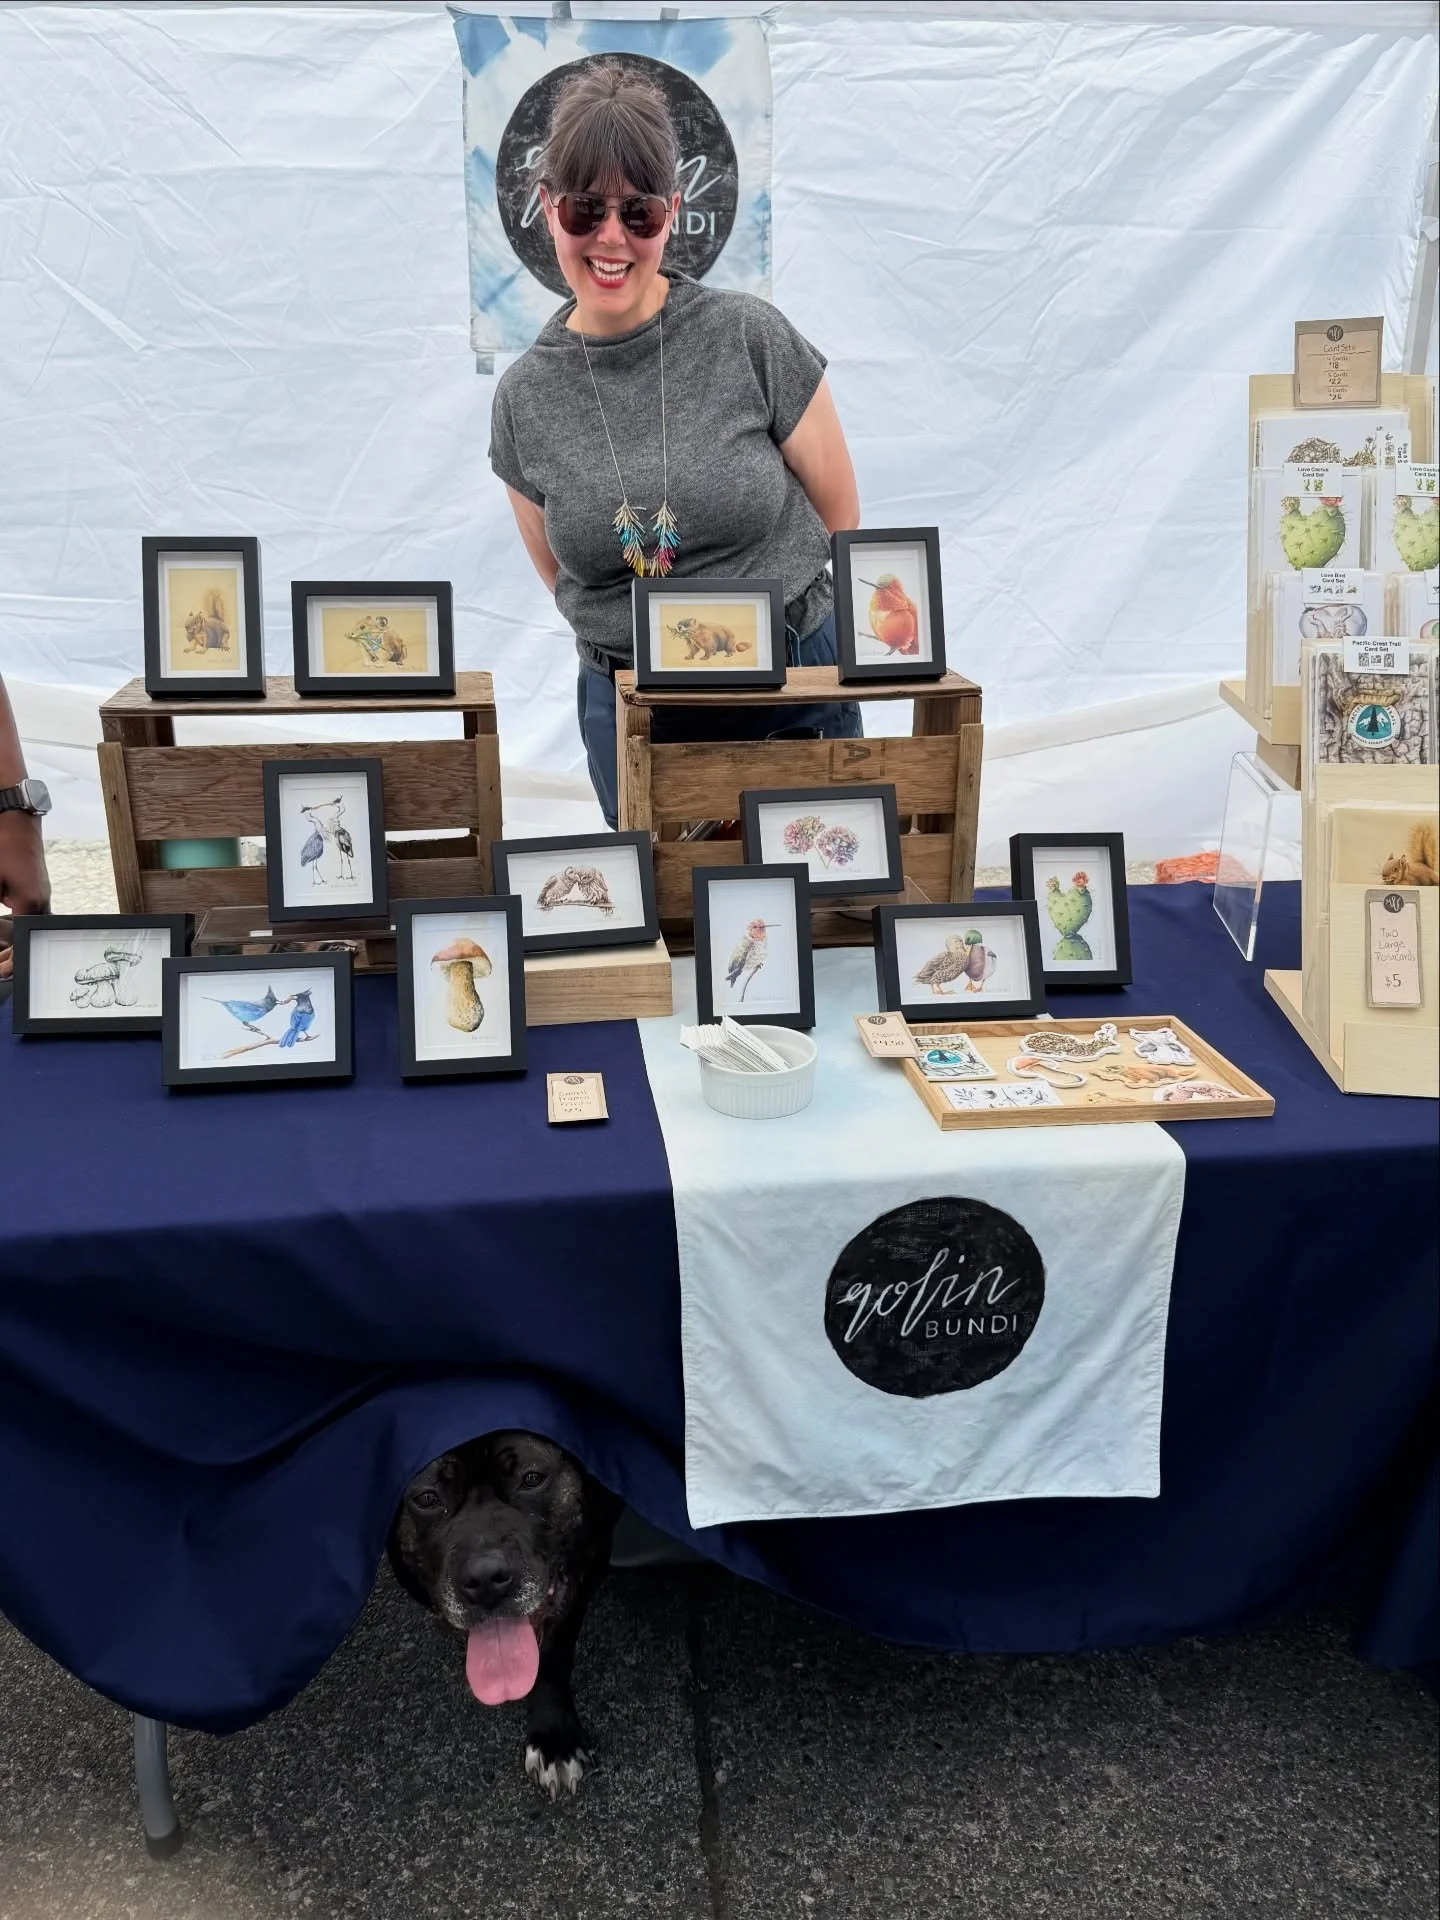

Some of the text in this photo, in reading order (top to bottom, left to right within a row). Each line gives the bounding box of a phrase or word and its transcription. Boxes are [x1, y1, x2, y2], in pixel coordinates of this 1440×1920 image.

[1380, 928, 1399, 938] Two
[1379, 940, 1406, 952] Large
[1374, 950, 1416, 962] Postcards
[1384, 973, 1402, 989] $5
[925, 1315, 1017, 1338] BUNDI
